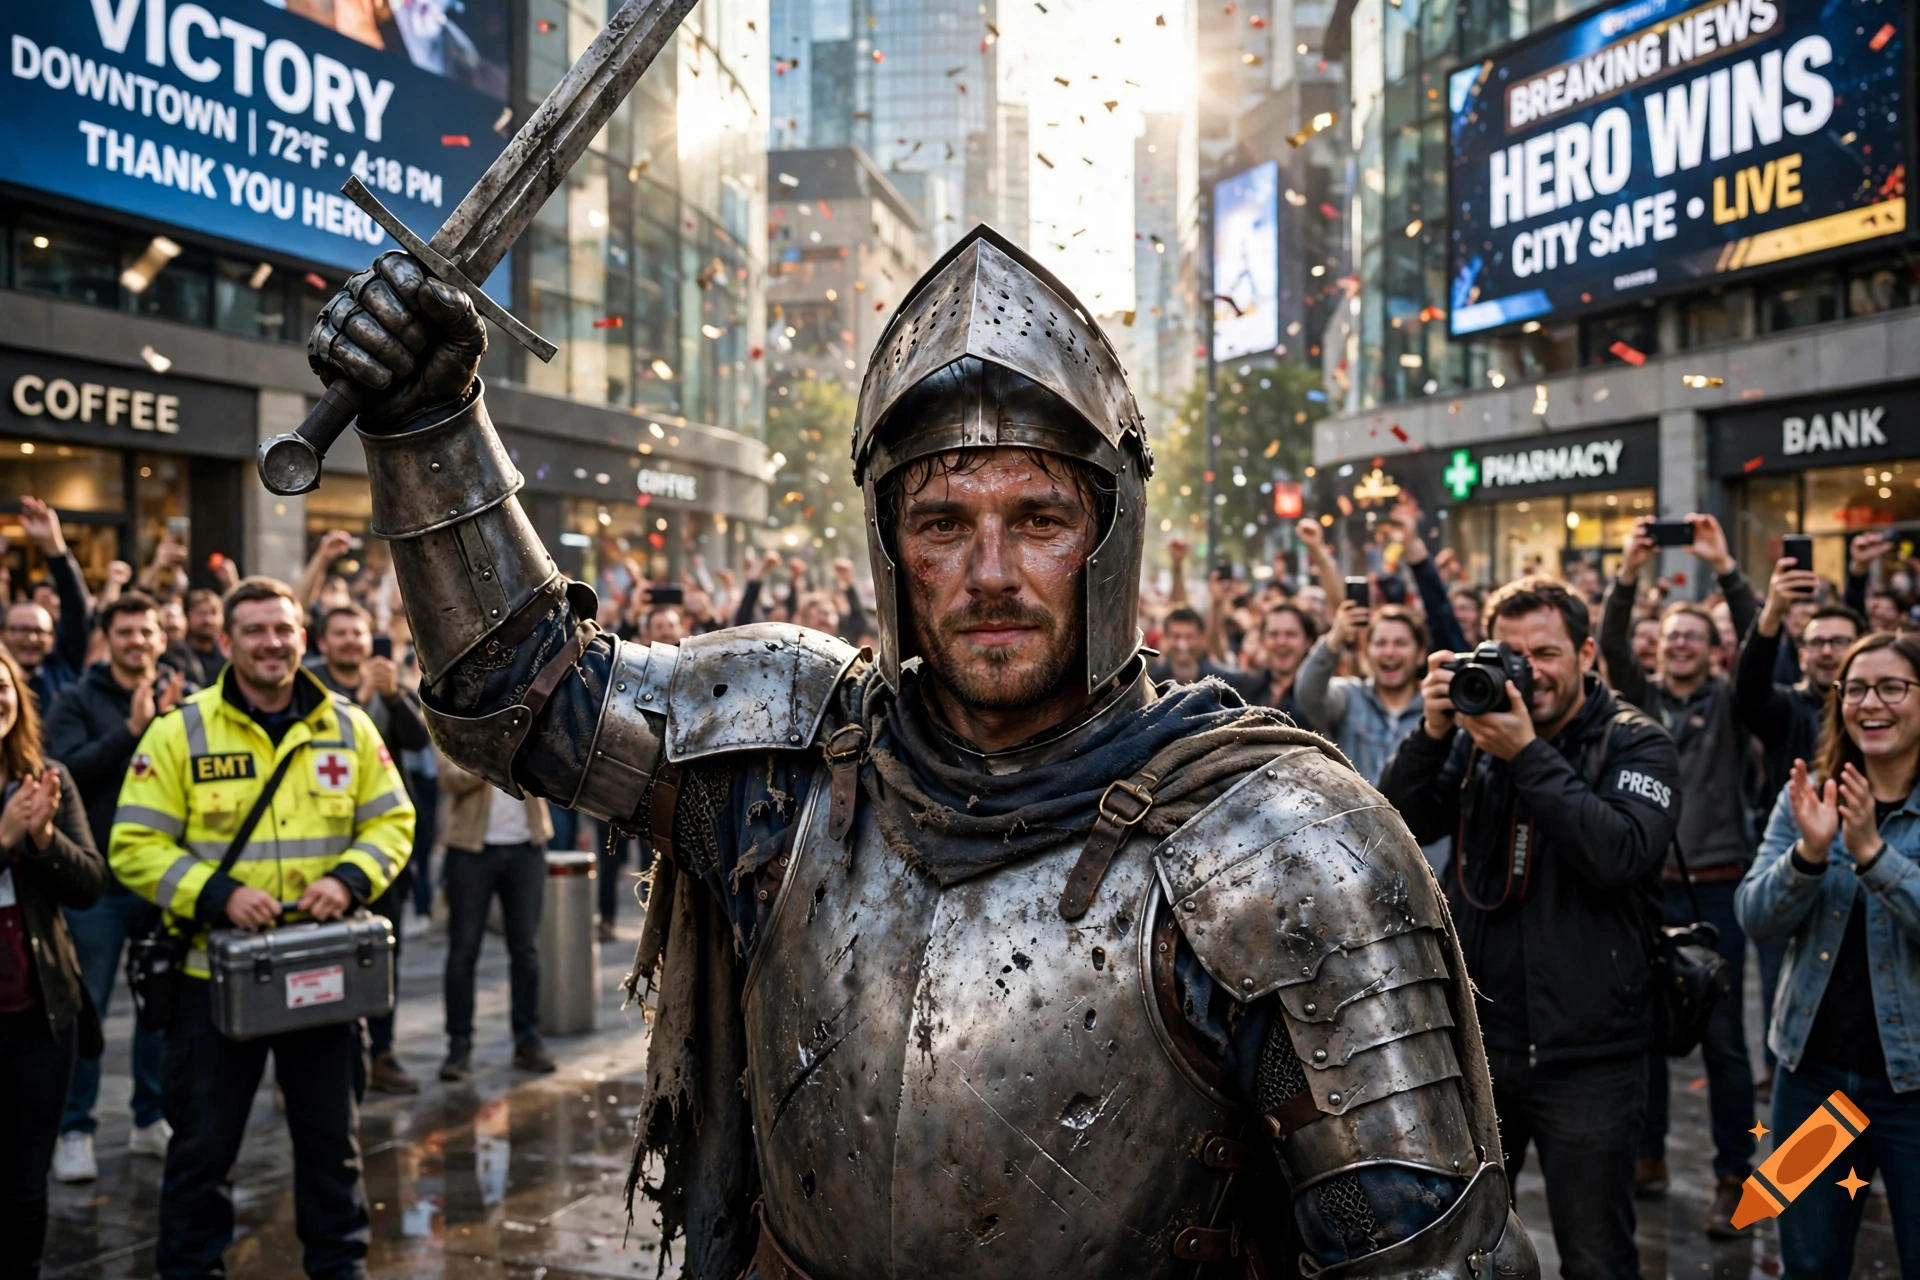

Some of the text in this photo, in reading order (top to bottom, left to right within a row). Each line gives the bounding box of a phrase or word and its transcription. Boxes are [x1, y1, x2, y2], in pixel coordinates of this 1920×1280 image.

[13, 35, 442, 207] DOWNTOWN 72°F 4:18 PM
[91, 0, 395, 142] VICTORY
[1509, 31, 1662, 127] BREAKING
[1668, 0, 1778, 67] NEWS
[79, 121, 386, 246] THANK YOU HERO
[1489, 35, 1834, 228] HERO WINS
[1512, 153, 1803, 277] CITY SAFE LIVE
[13, 375, 179, 434] COFFEE
[1481, 439, 1624, 488] PHARMACY
[1782, 407, 1888, 455] BANK
[197, 755, 249, 779] EMT
[1617, 769, 1671, 808] PRESS
